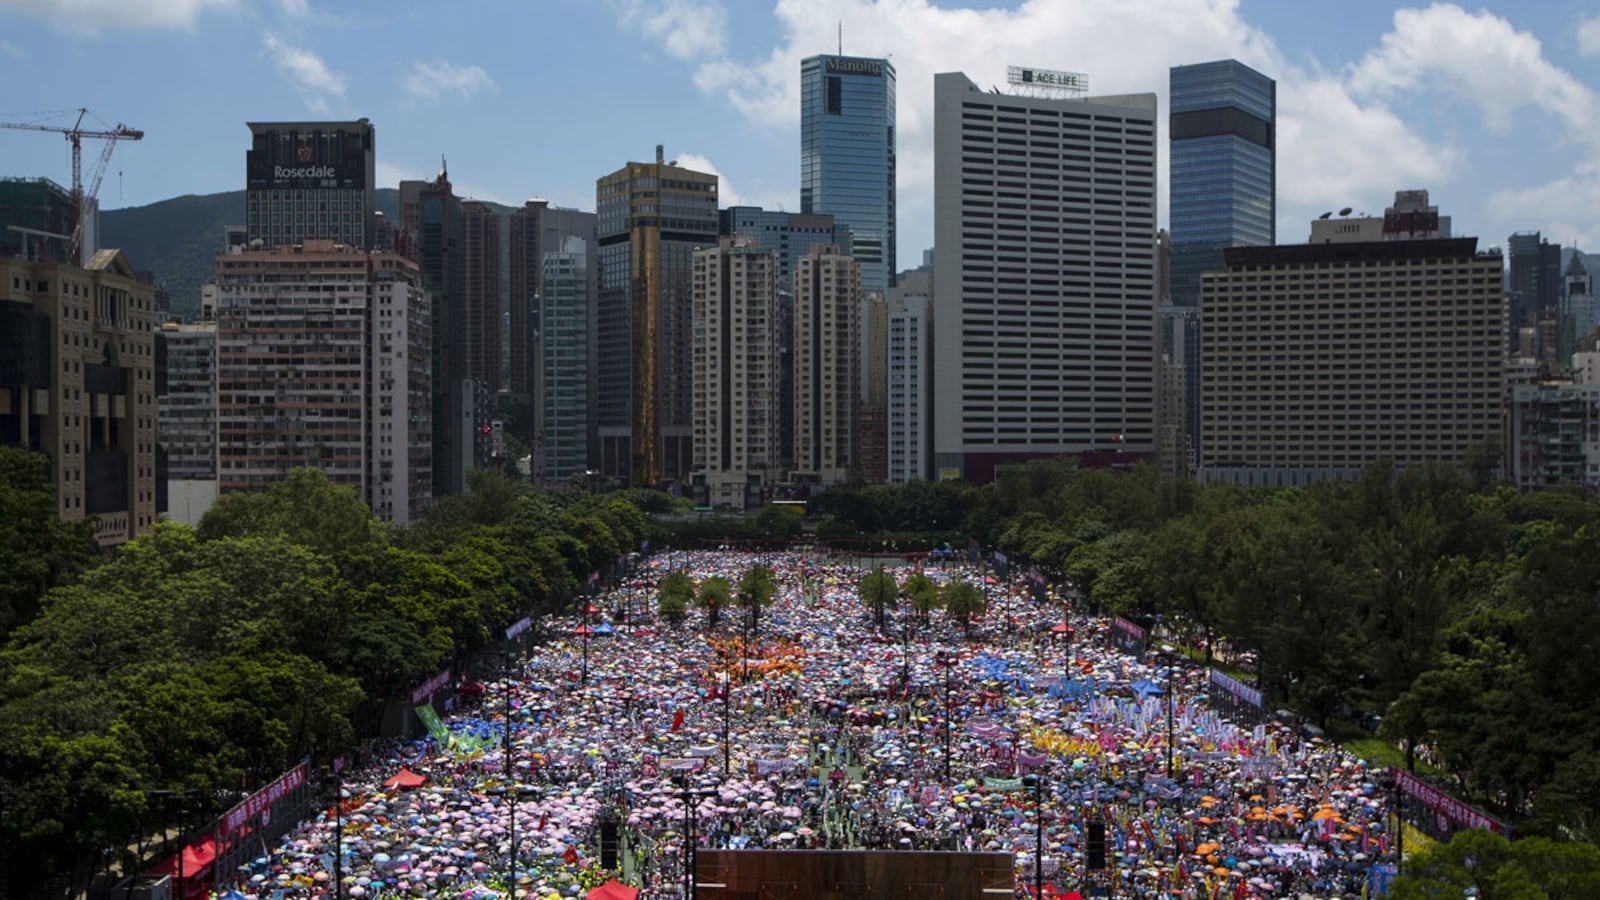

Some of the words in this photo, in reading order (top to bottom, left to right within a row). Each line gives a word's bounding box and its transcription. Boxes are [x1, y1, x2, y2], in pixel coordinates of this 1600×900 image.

[1036, 73, 1055, 83] ACE
[1059, 75, 1077, 86] LIFE
[274, 165, 336, 178] Rosedale
